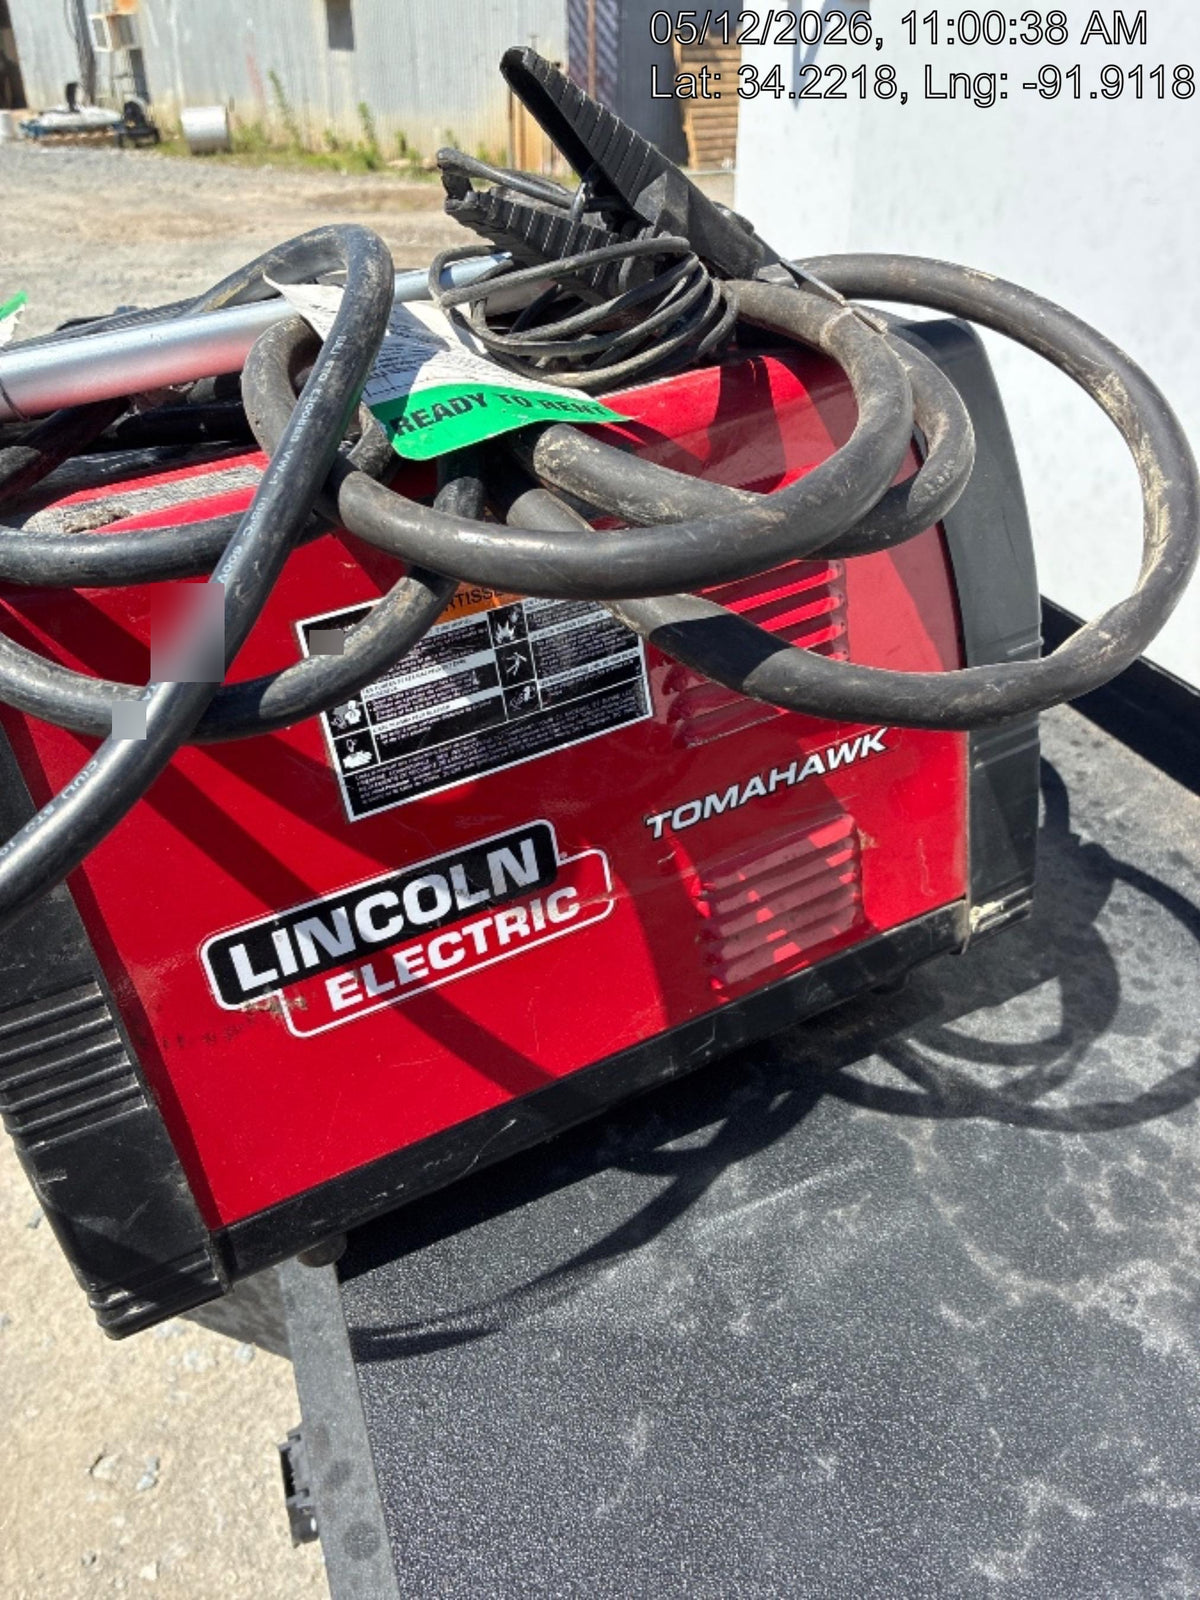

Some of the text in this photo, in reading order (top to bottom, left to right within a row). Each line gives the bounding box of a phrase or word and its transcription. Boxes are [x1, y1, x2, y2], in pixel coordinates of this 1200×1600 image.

[389, 392, 606, 438] READY TO RENT
[644, 726, 889, 841] TOMAHAWK
[229, 838, 540, 992] LINCOLN
[325, 886, 580, 1012] ELECTRIC
